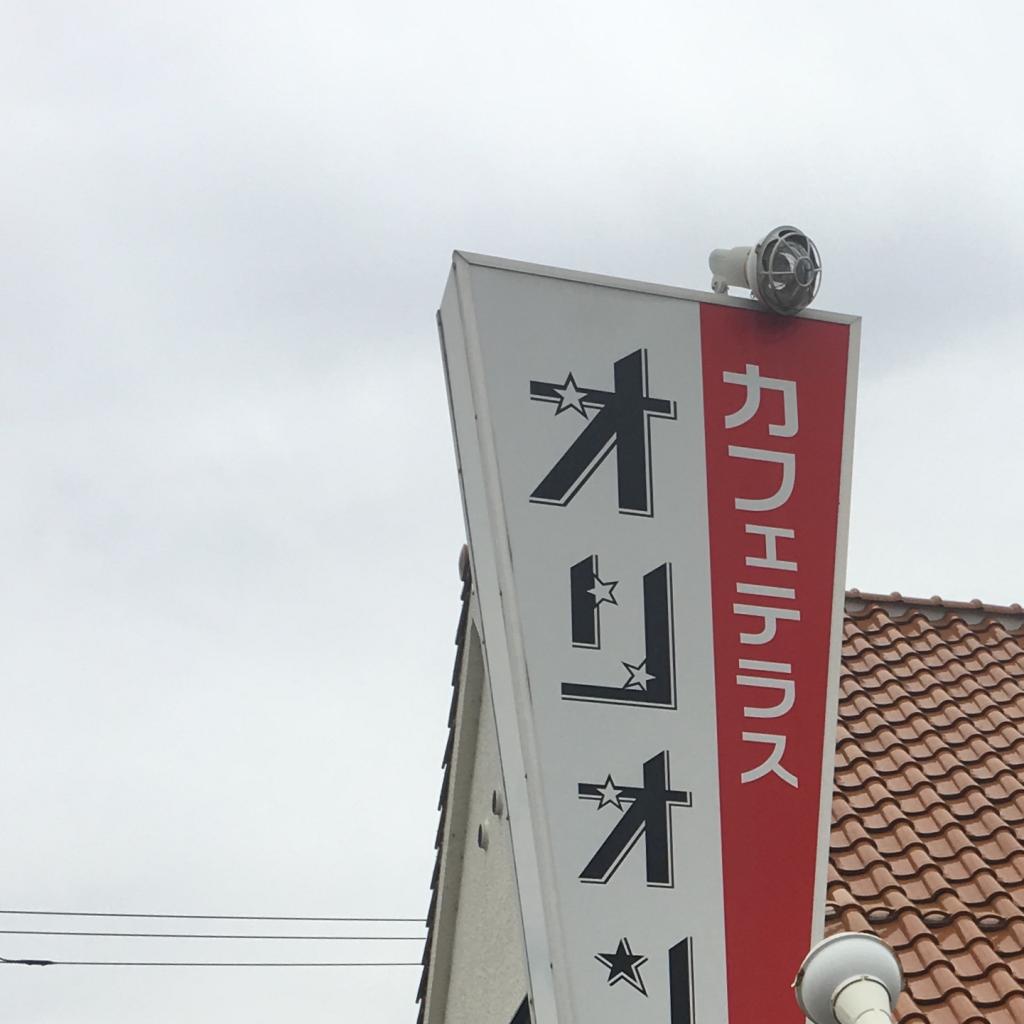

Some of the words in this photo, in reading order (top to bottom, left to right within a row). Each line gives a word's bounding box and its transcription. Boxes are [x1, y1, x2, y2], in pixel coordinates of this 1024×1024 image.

[722, 363, 801, 788] カフェテラス
